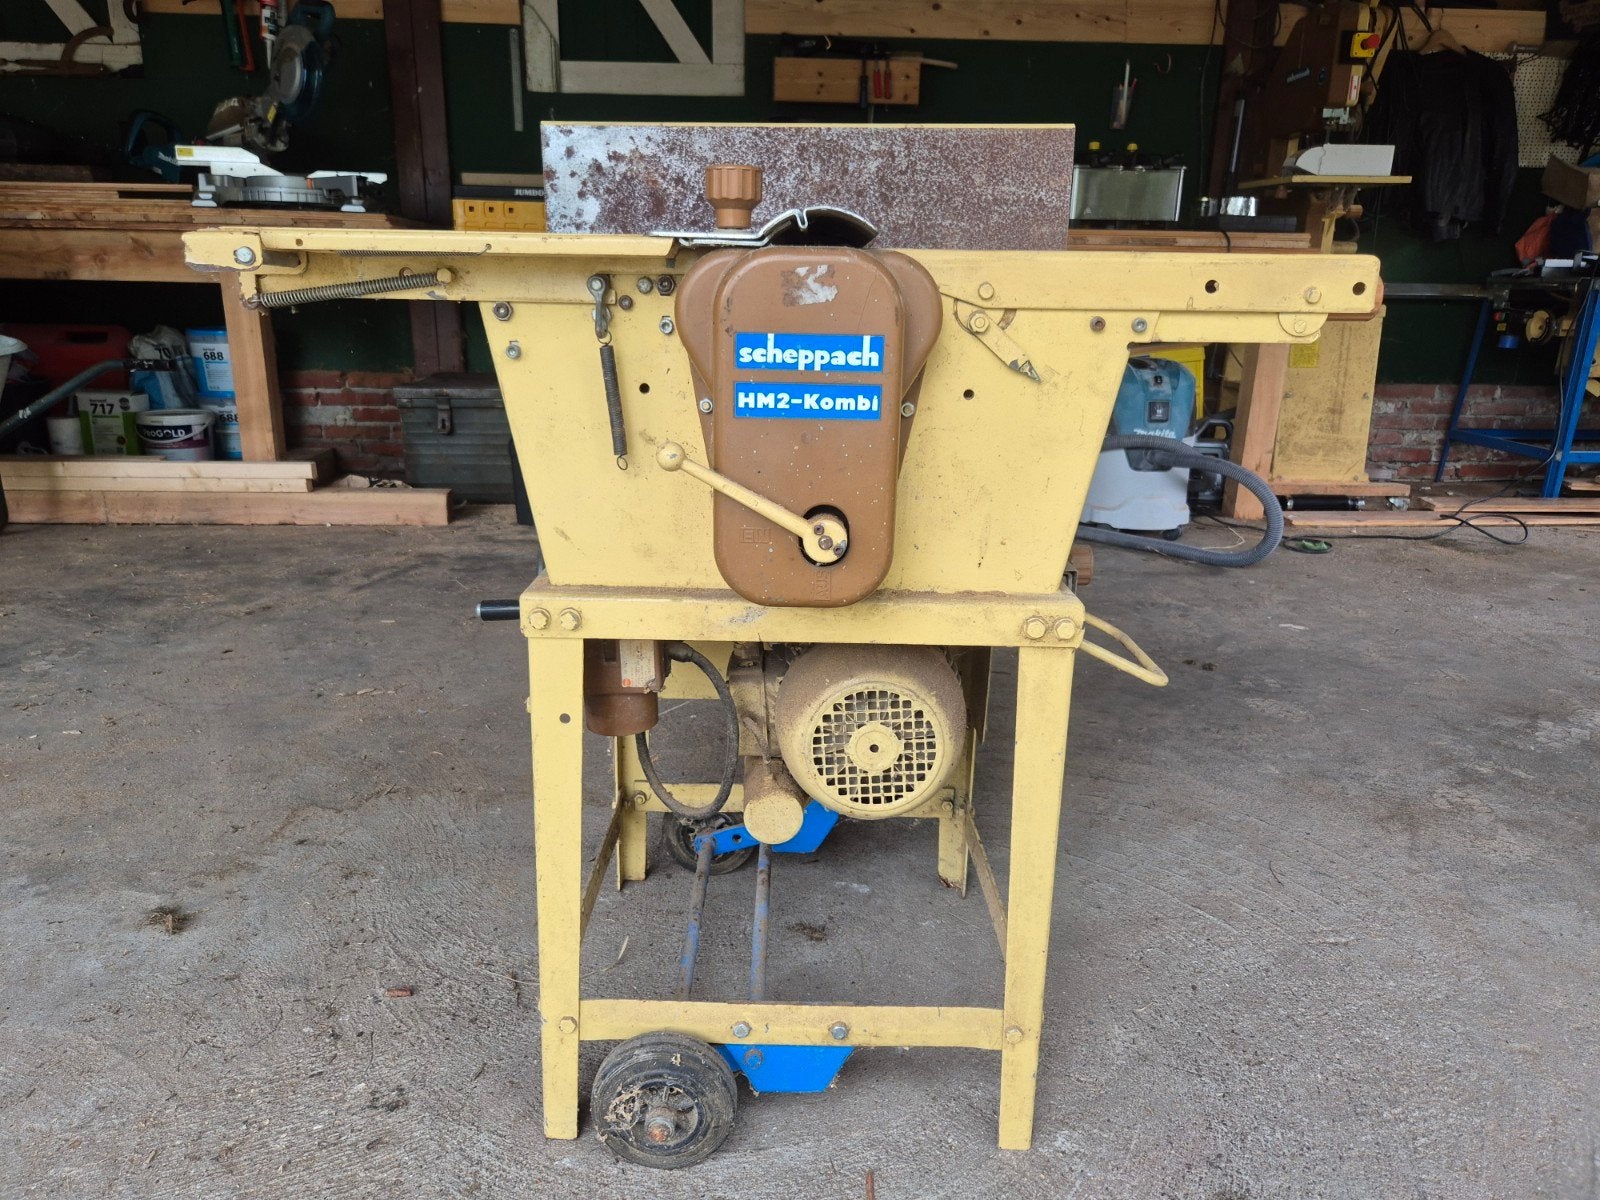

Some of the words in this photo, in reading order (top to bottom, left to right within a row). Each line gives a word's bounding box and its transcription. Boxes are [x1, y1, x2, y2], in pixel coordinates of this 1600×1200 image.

[203, 351, 224, 361] 688
[739, 333, 880, 371] scheppach
[89, 403, 114, 415] 717
[738, 391, 879, 412] HM2-Kombi
